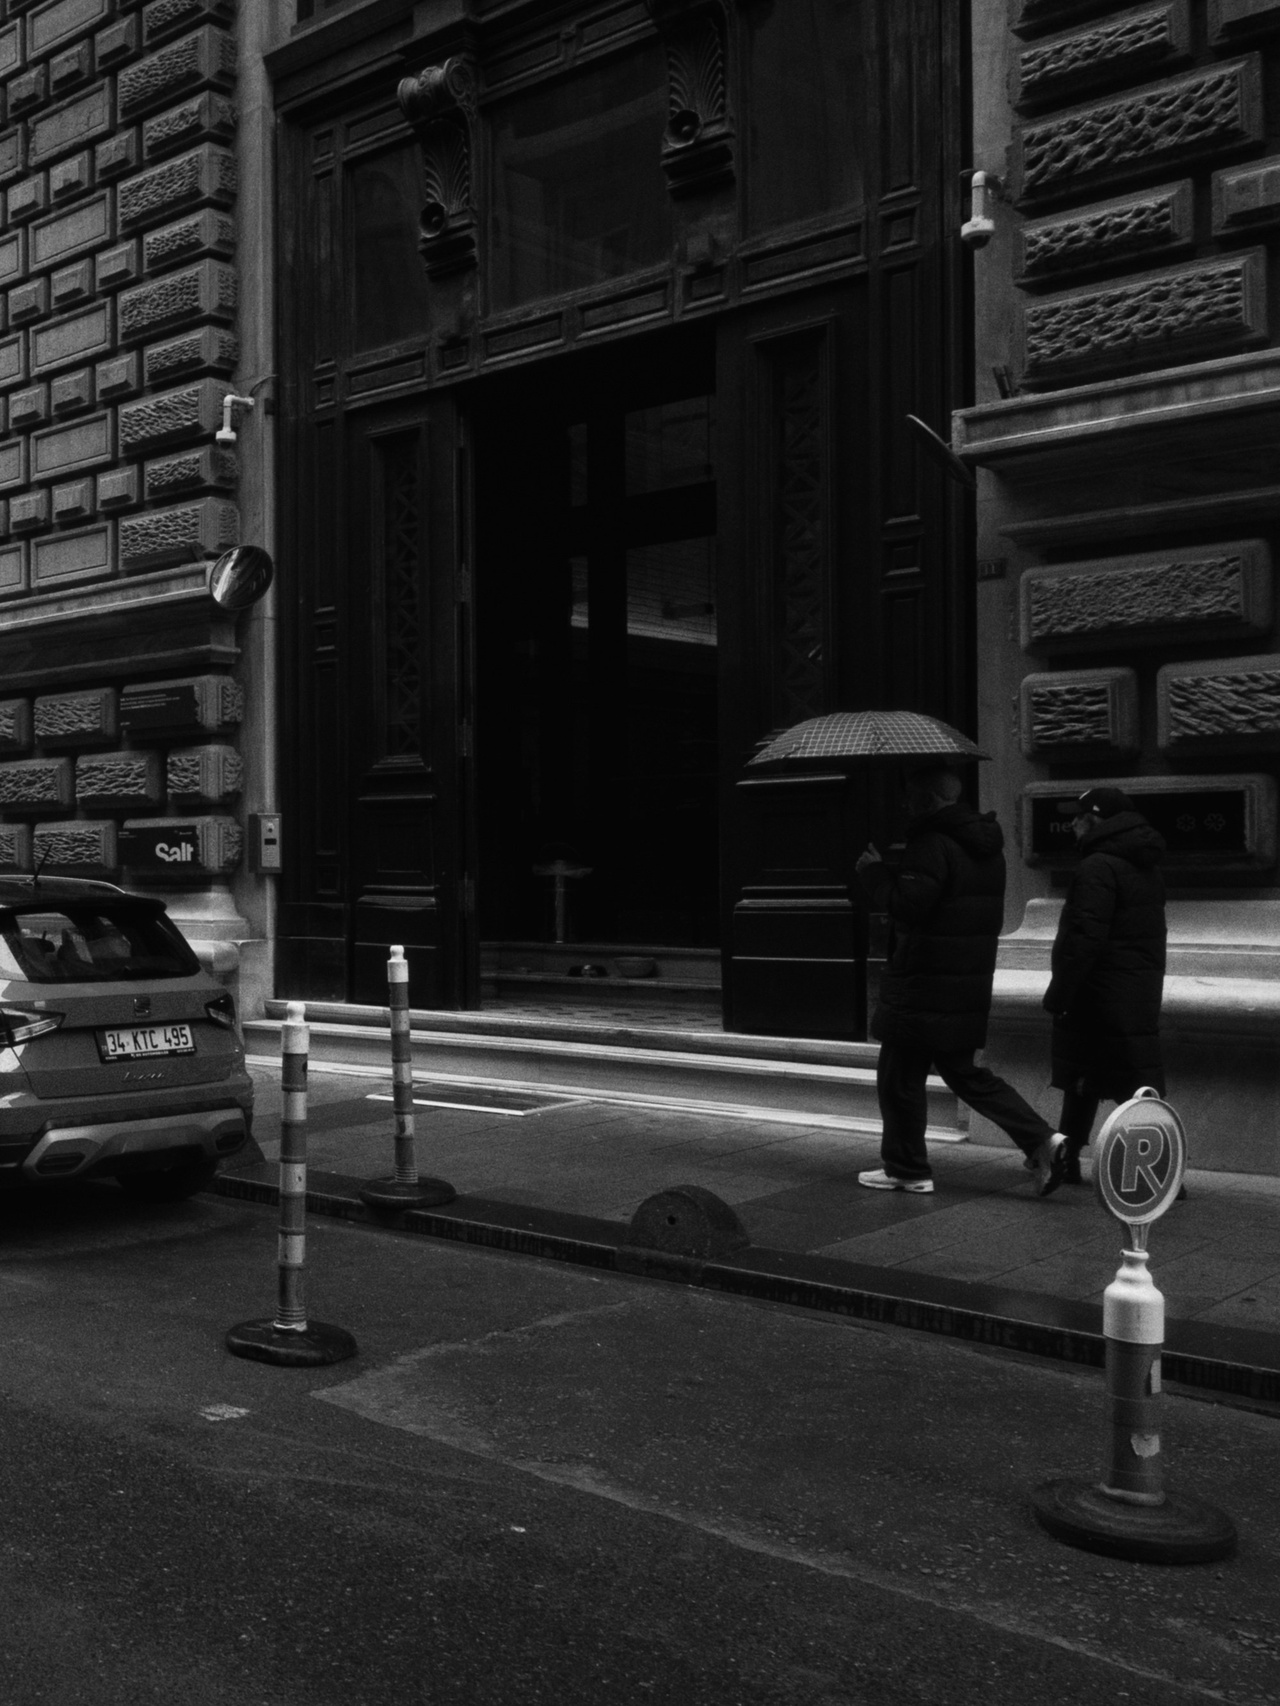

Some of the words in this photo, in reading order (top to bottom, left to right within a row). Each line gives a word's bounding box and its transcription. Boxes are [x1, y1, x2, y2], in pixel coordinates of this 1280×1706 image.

[155, 842, 194, 862] Salt
[107, 1033, 125, 1052] 34
[131, 1029, 158, 1050] KTC
[164, 1026, 189, 1047] 495
